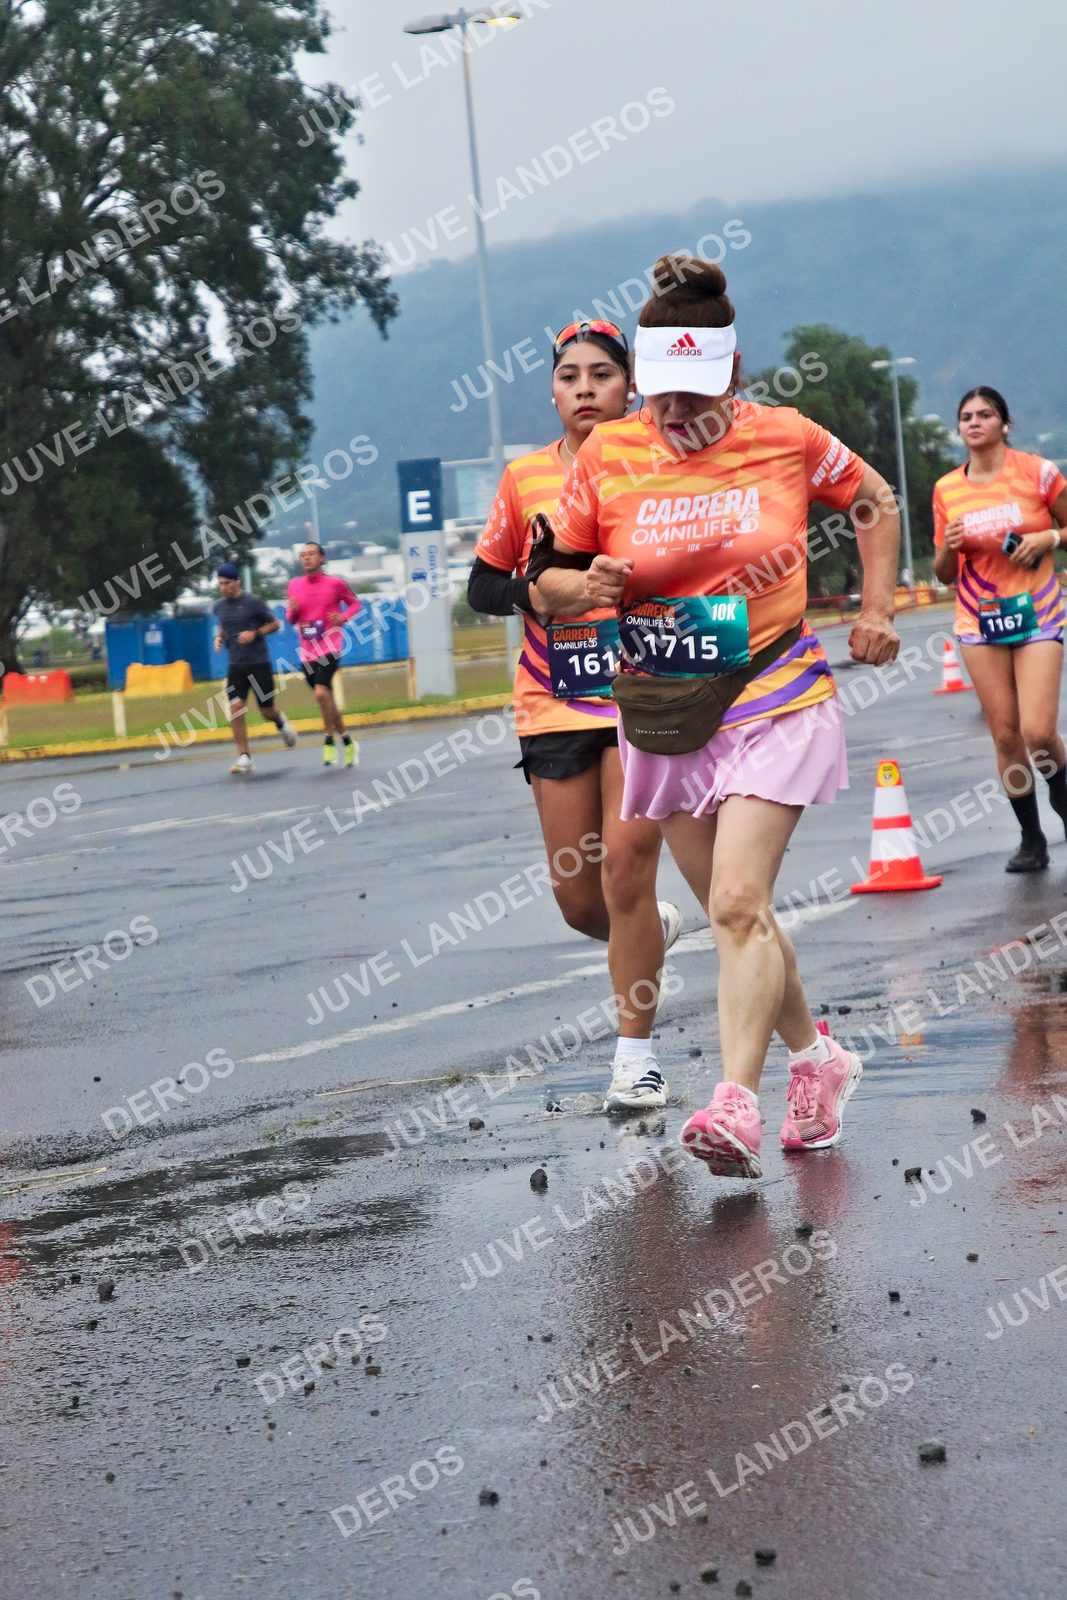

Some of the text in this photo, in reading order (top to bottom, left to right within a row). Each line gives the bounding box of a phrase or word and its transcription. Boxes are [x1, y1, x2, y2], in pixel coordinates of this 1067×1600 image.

[666, 347, 702, 356] adidas
[407, 489, 432, 523] E
[636, 487, 760, 526] CARRERA
[631, 518, 731, 545] OMNILIFE
[626, 615, 664, 628] OMNILIFE
[712, 603, 737, 621] 10K
[987, 613, 1023, 632] 1167
[553, 627, 597, 642] CARRERA
[553, 640, 587, 650] OMNILIFE
[643, 634, 719, 660] 1715
[568, 650, 622, 676] 161
